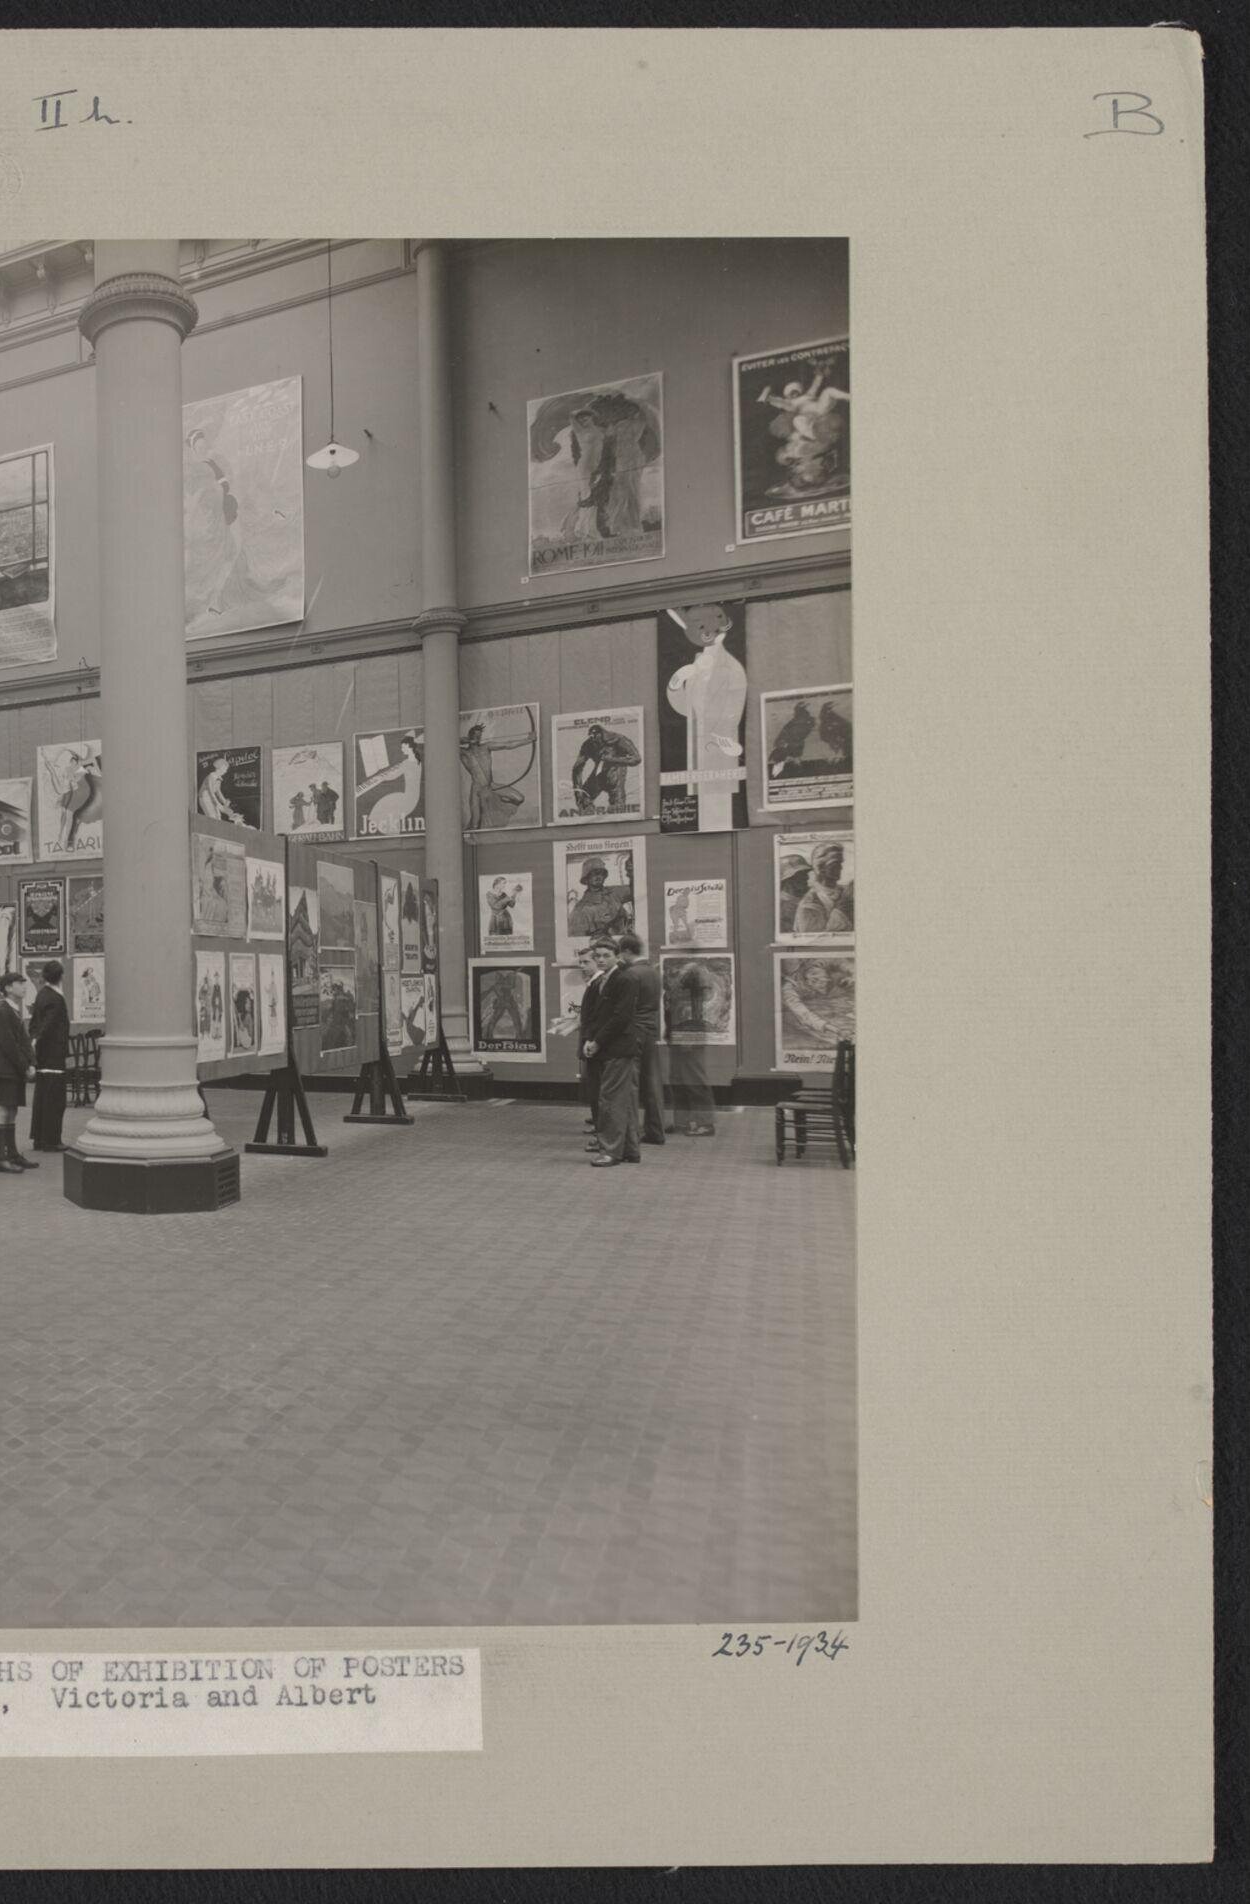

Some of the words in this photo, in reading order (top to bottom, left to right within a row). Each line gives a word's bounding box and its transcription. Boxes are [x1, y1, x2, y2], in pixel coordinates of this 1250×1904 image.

[1083, 91, 1165, 139] B
[750, 506, 794, 526] CAFÉ
[532, 544, 579, 567] ROME
[43, 836, 102, 853] TABARI
[711, 1629, 850, 1667] 235-1934
[51, 1659, 84, 1682] OF
[102, 1658, 274, 1683] EXHIBITION
[294, 1656, 326, 1680] OF
[343, 1654, 465, 1679] POSTERS
[51, 1686, 188, 1710] Victoria
[206, 1686, 258, 1708] and
[275, 1683, 377, 1707] Albert
